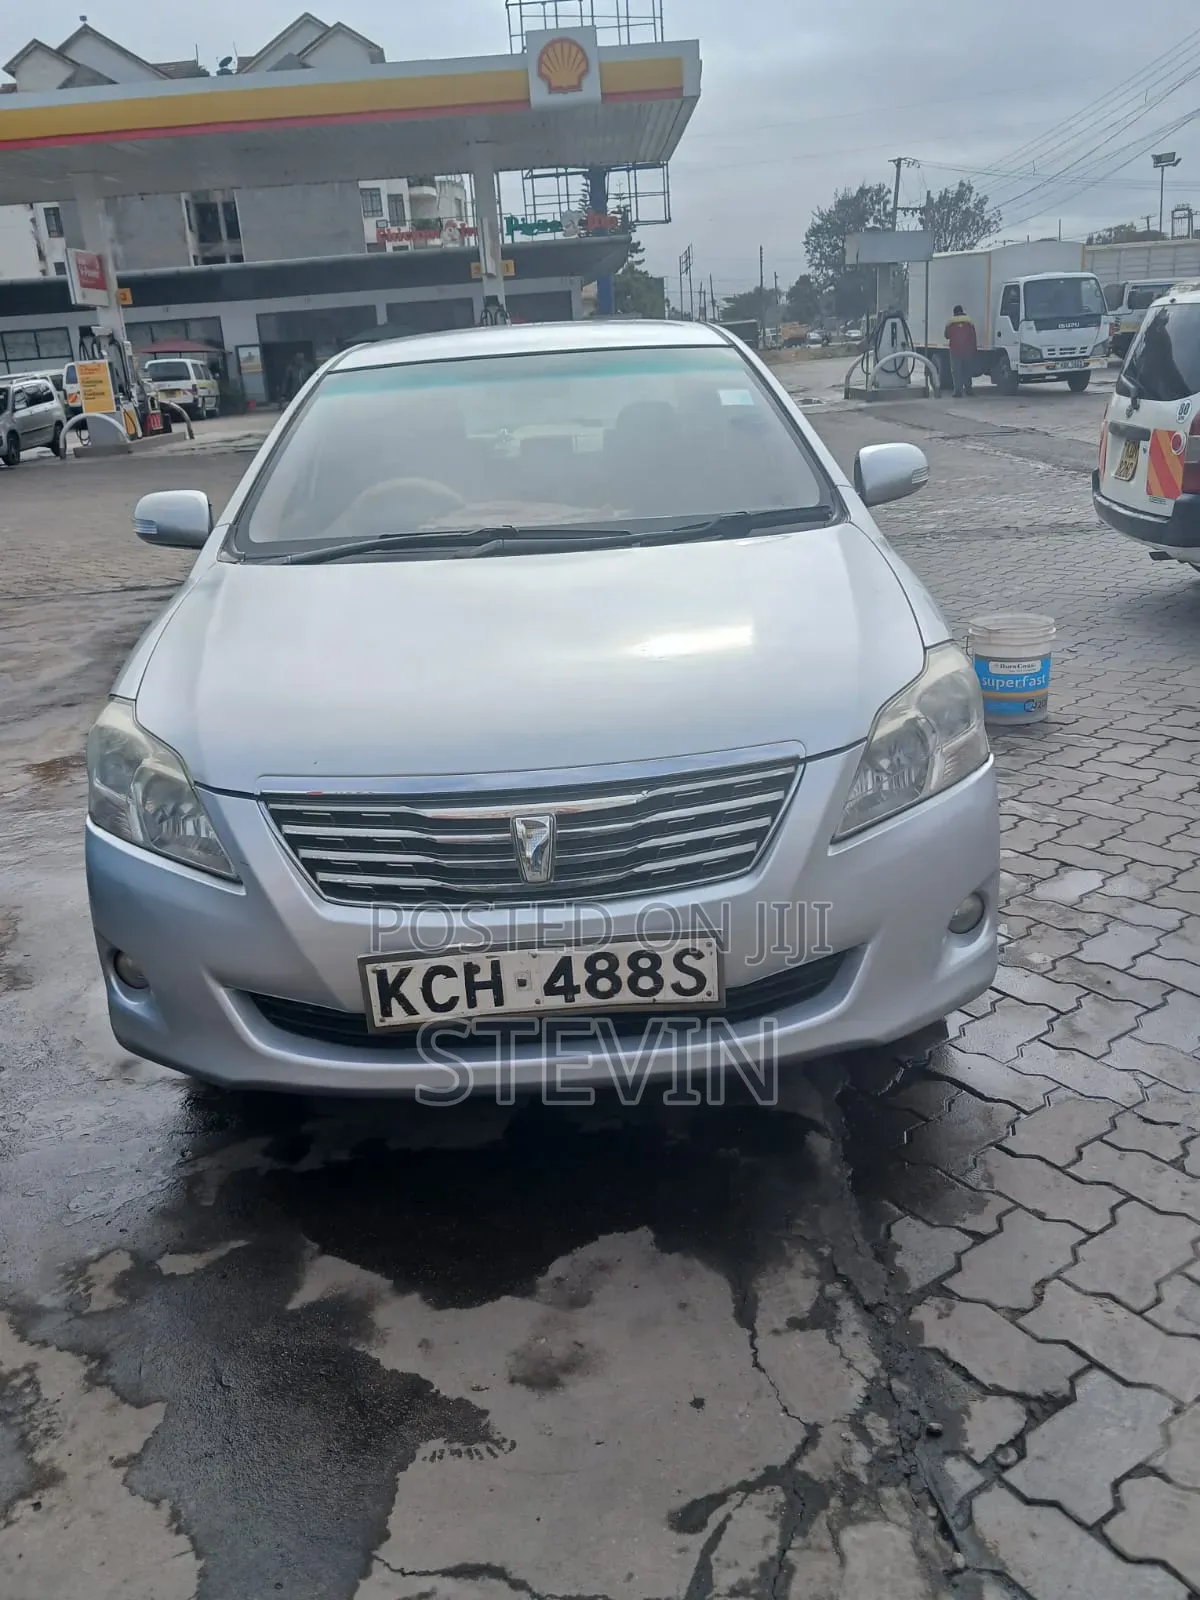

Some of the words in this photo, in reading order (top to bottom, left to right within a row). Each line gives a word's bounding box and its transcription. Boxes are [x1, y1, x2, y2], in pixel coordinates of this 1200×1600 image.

[1178, 402, 1191, 416] 80
[982, 674, 1046, 690] superfast
[374, 959, 505, 1019] KCH
[542, 947, 708, 1004] 488S
